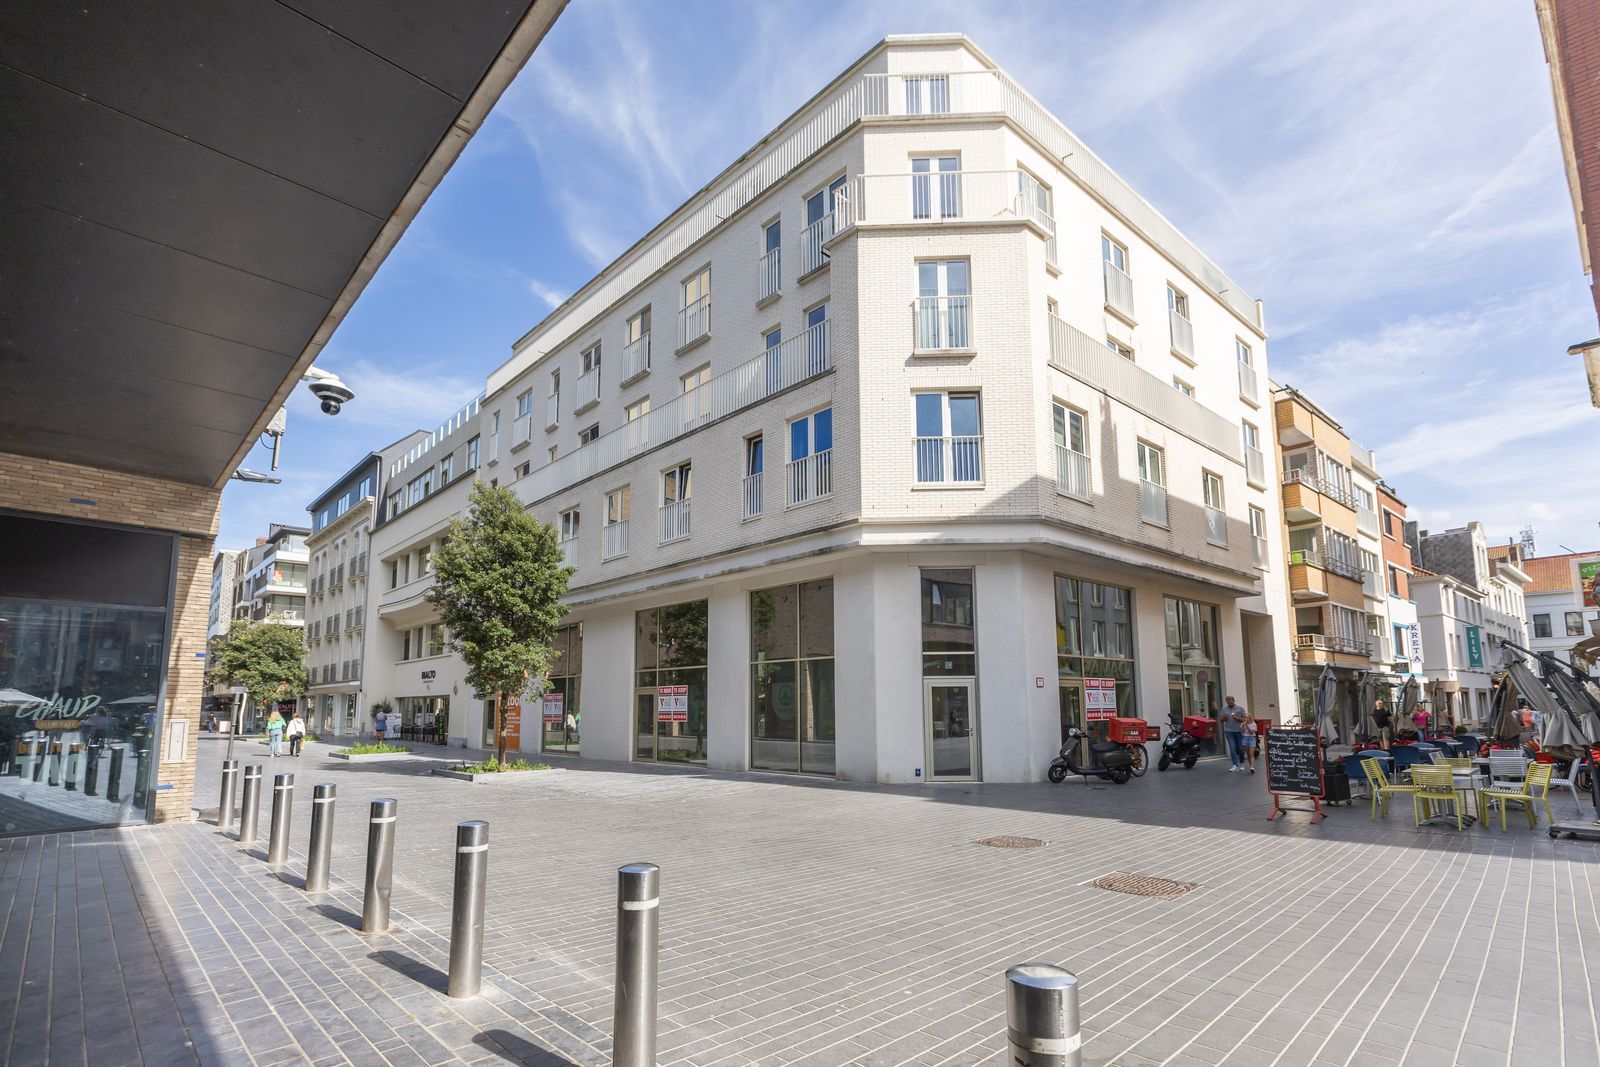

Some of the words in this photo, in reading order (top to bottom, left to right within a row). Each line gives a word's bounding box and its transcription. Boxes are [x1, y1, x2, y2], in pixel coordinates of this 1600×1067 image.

[1410, 624, 1421, 662] KRETA
[1470, 631, 1479, 660] LILY
[15, 692, 101, 720] CHAUD
